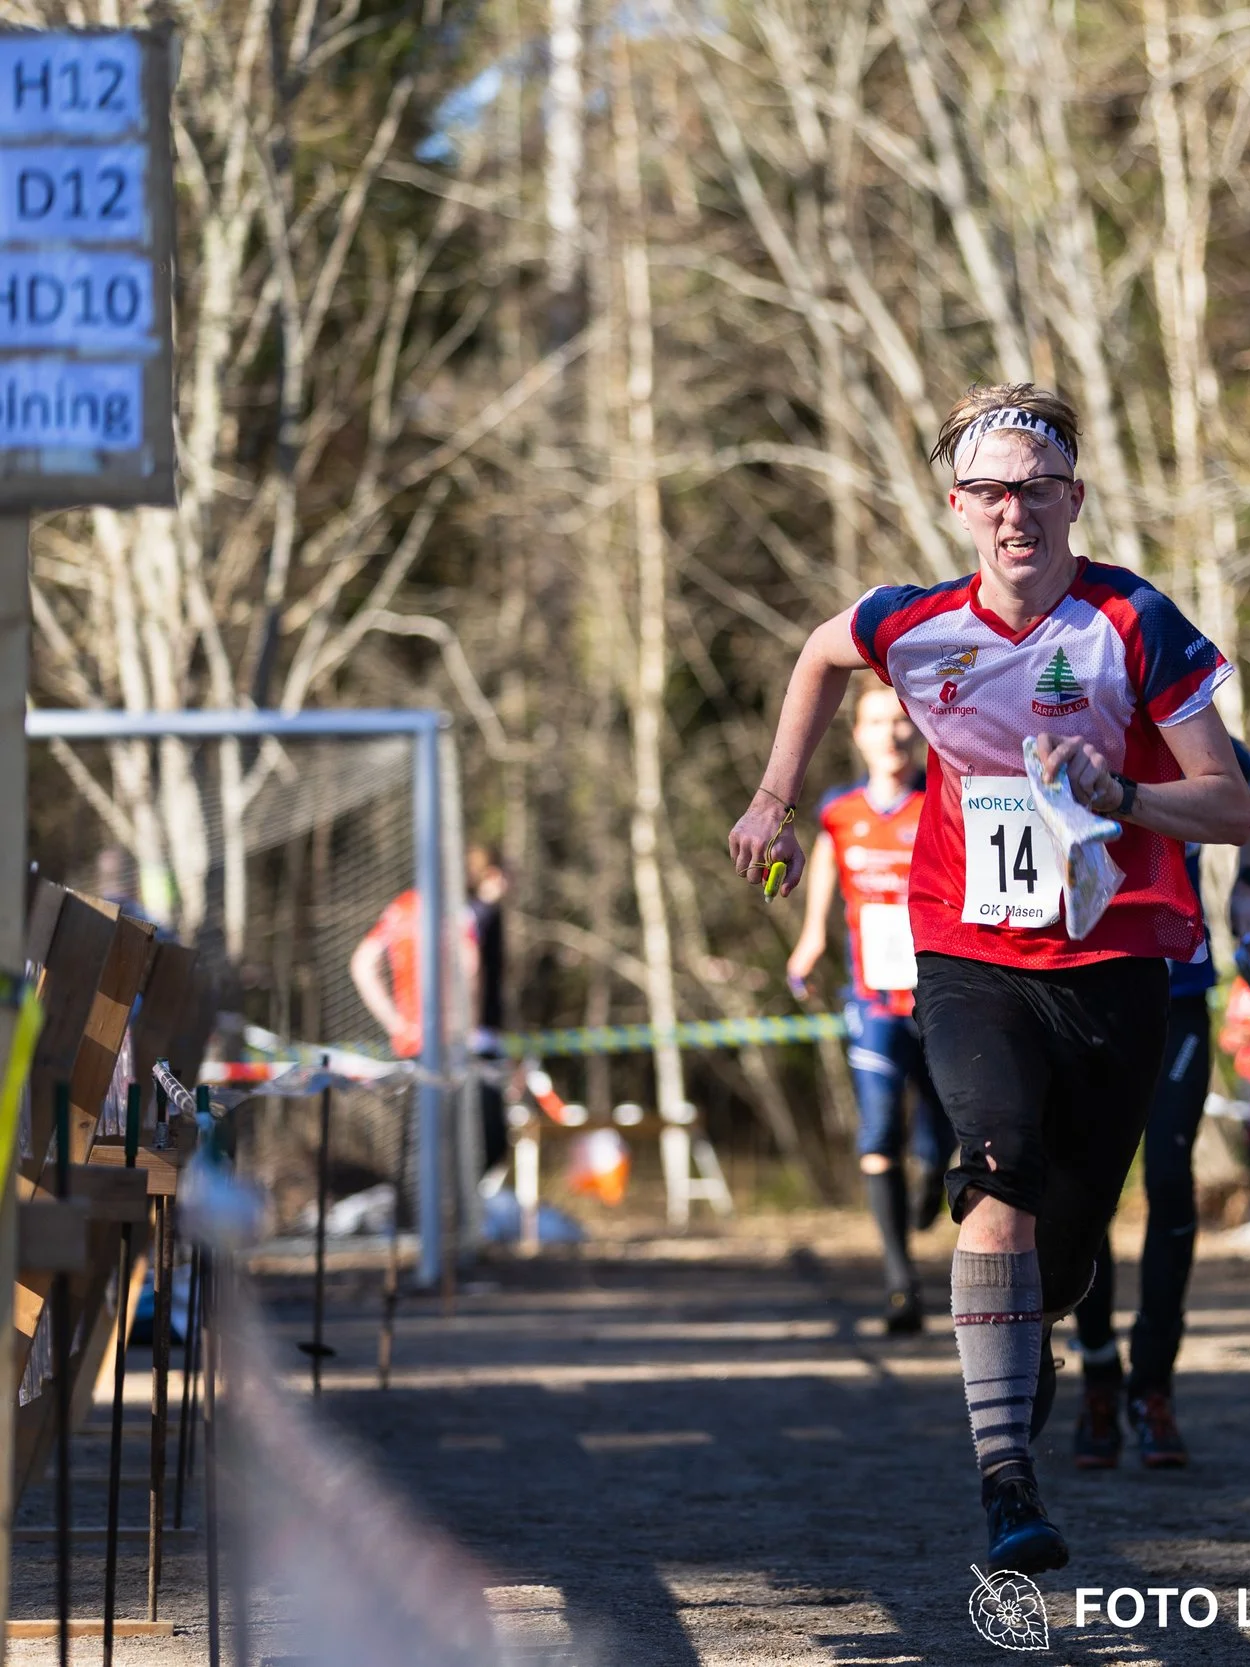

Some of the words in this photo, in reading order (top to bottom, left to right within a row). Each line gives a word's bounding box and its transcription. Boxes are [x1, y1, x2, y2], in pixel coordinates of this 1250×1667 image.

[14, 59, 126, 111] H12
[18, 166, 128, 220] D12
[0, 378, 132, 441] lning
[968, 797, 1025, 812] NOREX
[990, 824, 1038, 894] 14
[980, 903, 1001, 916] OK
[1005, 904, 1043, 918] Måsen
